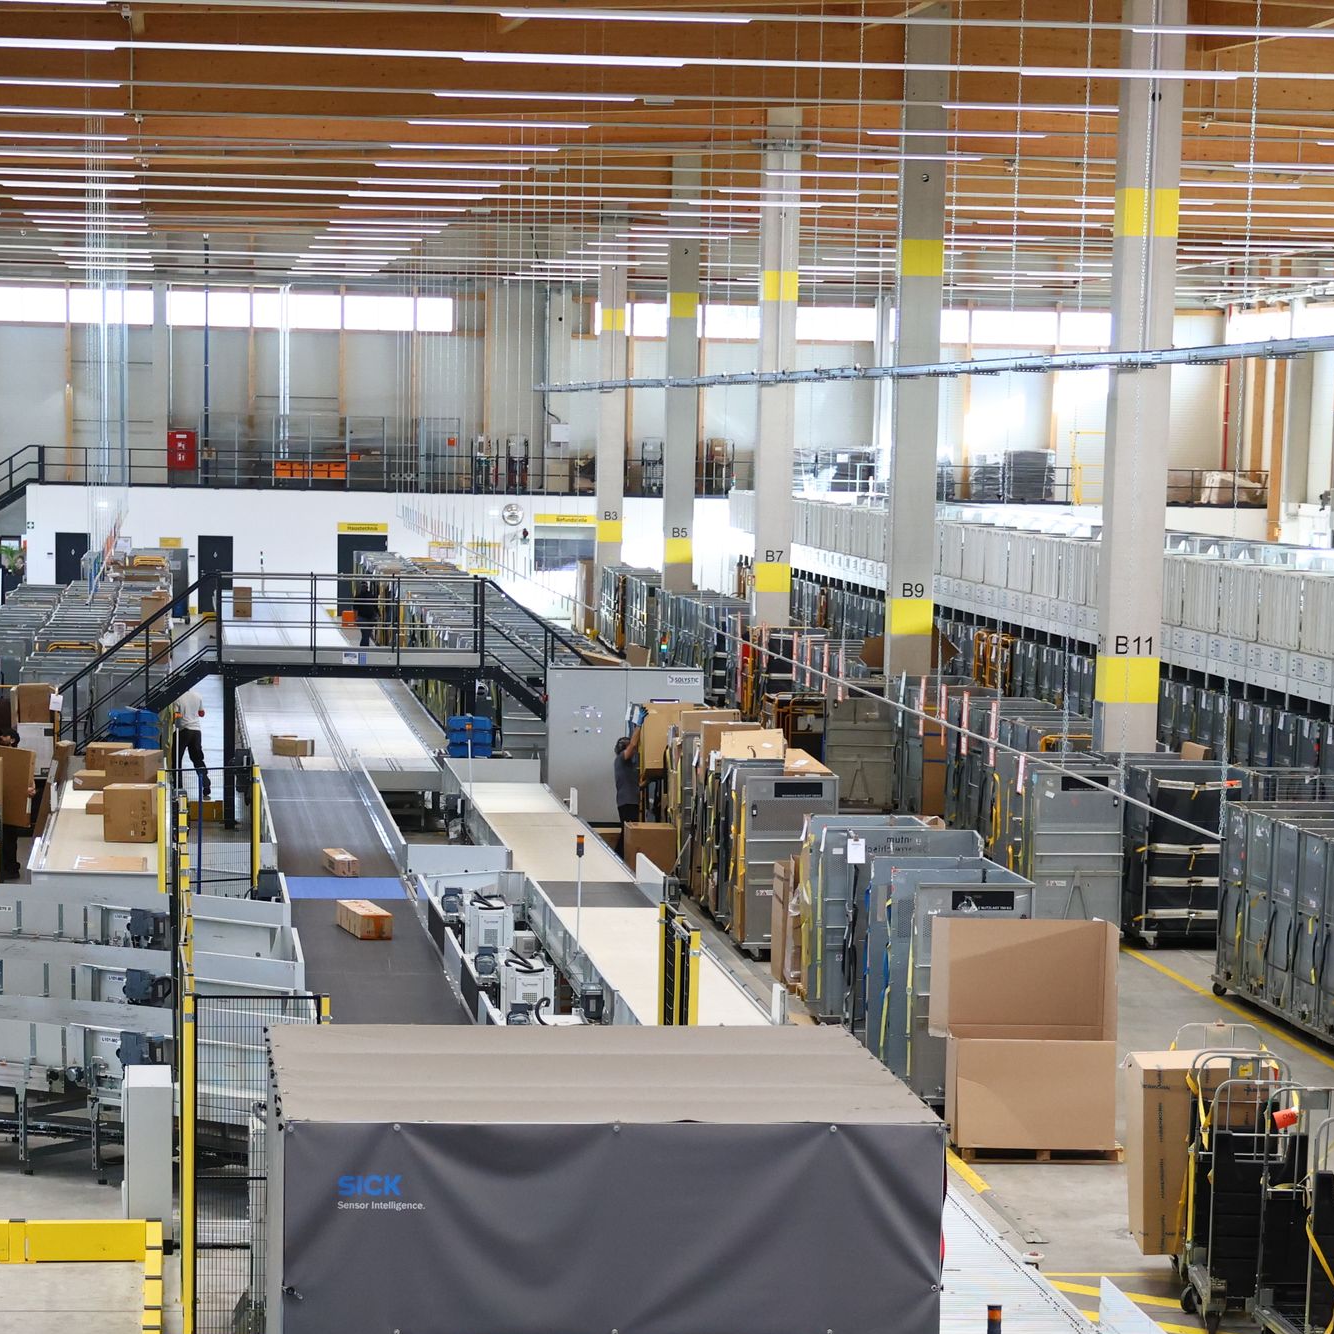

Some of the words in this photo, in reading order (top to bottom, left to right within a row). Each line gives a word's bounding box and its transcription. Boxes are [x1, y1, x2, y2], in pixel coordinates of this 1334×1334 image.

[604, 511, 618, 521] B3
[672, 527, 688, 538] B5
[766, 550, 784, 562] B7
[902, 582, 925, 598] B9
[1115, 636, 1153, 655] B11
[337, 1174, 403, 1197] SICK
[337, 1200, 369, 1210] Sensor
[371, 1200, 426, 1212] Intelligence.
